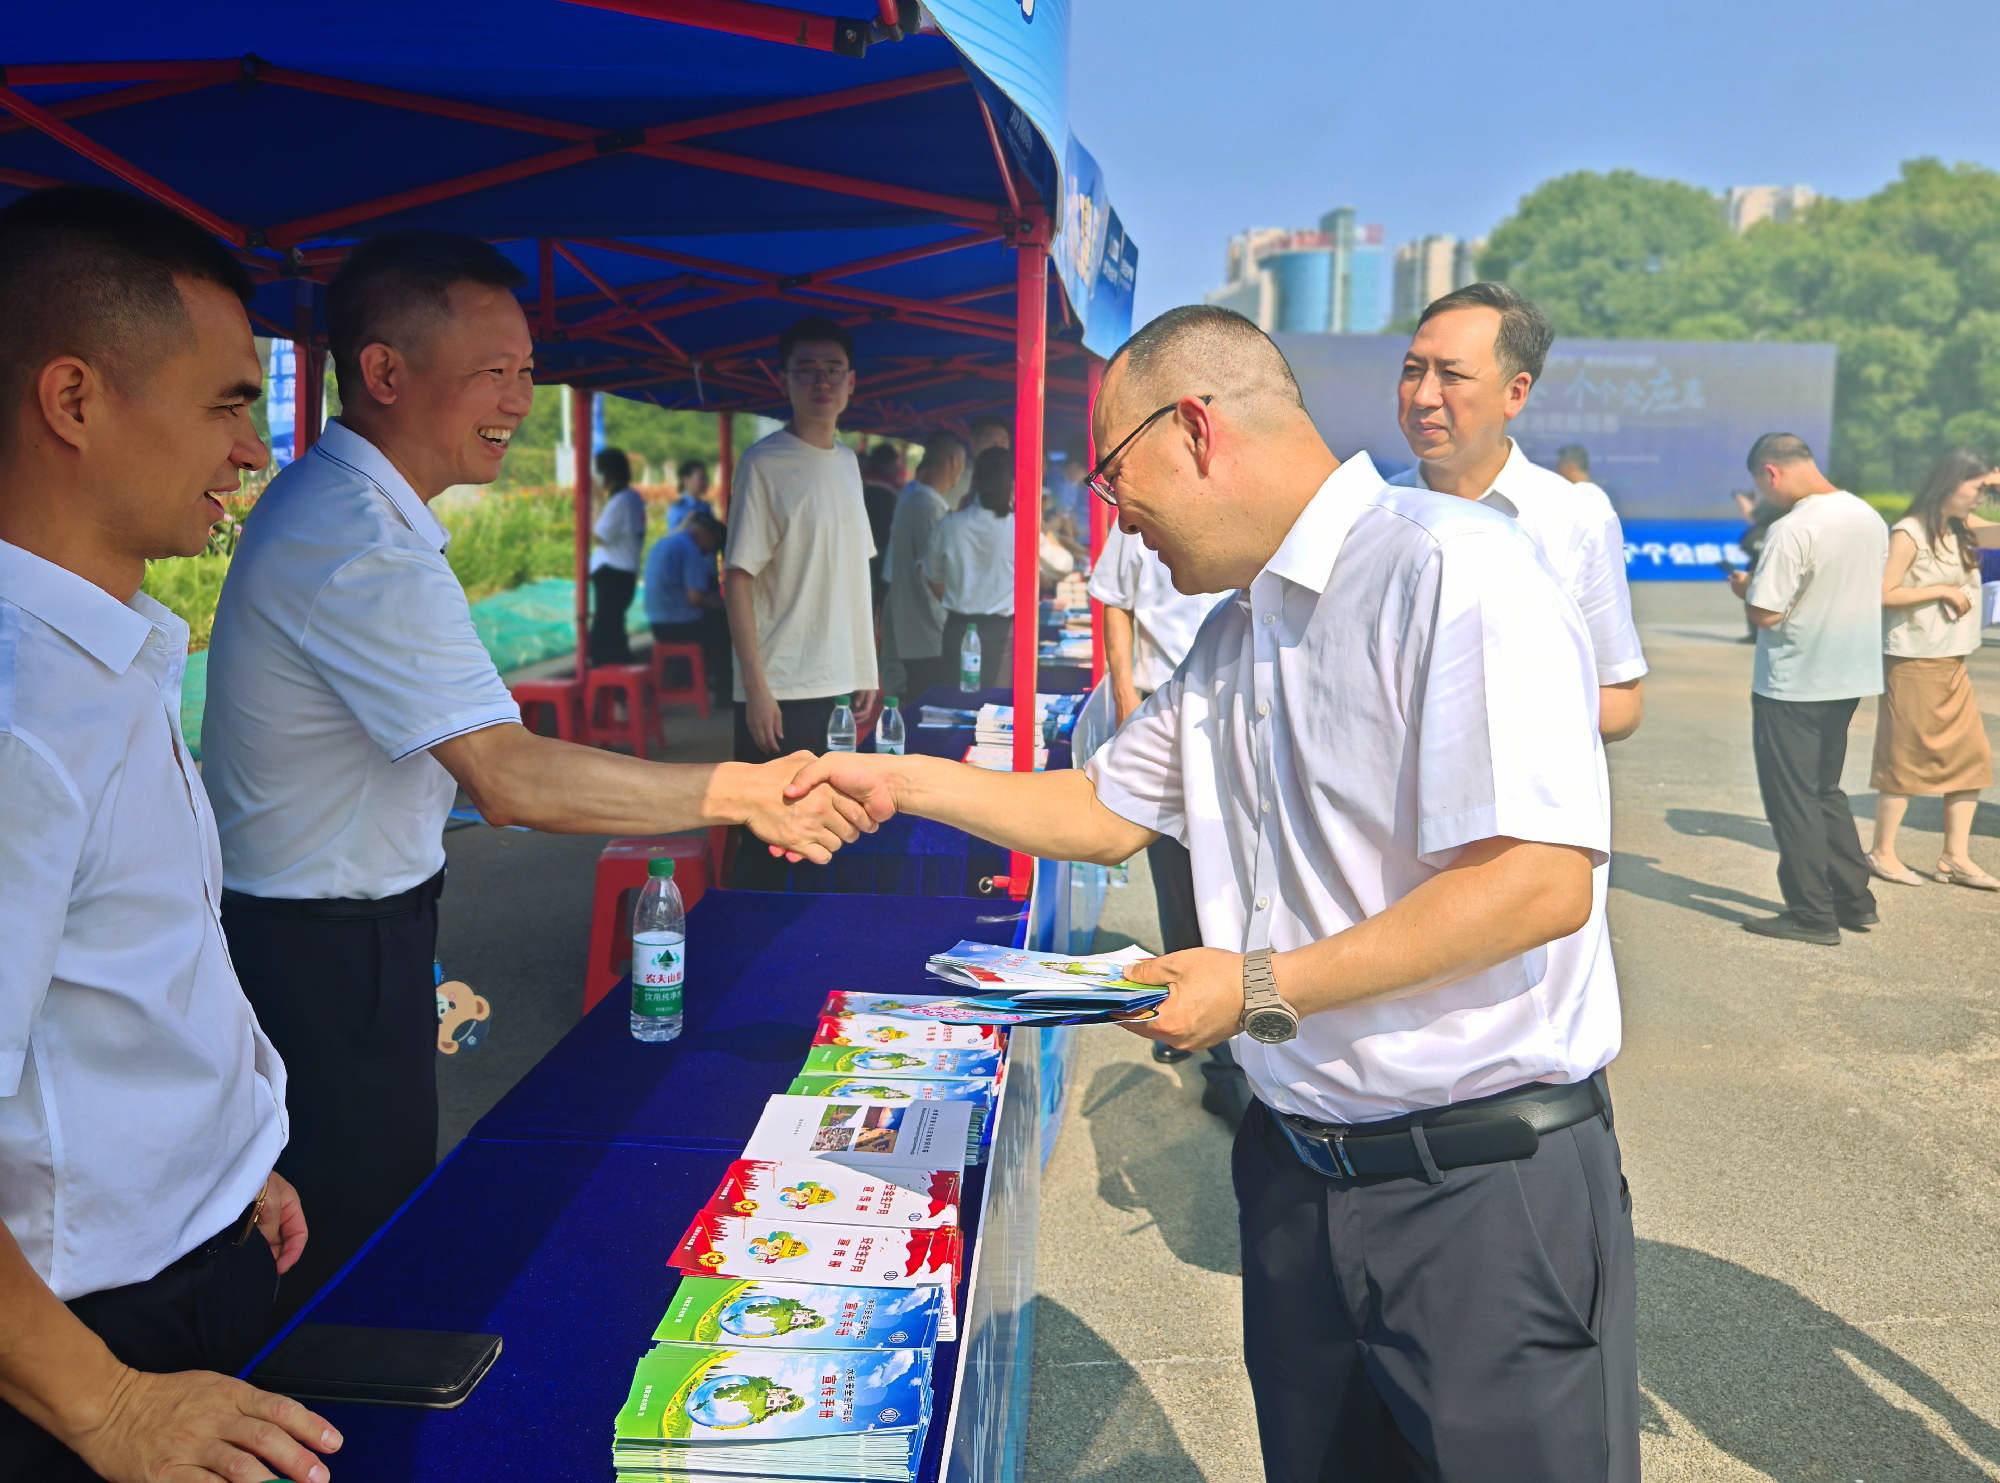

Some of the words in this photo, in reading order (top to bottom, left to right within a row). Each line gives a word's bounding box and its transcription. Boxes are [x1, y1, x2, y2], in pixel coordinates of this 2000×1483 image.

[850, 1236, 874, 1273] 安全生产月
[835, 1302, 858, 1337] 宣传手册
[818, 1374, 838, 1420] 宣传手册
